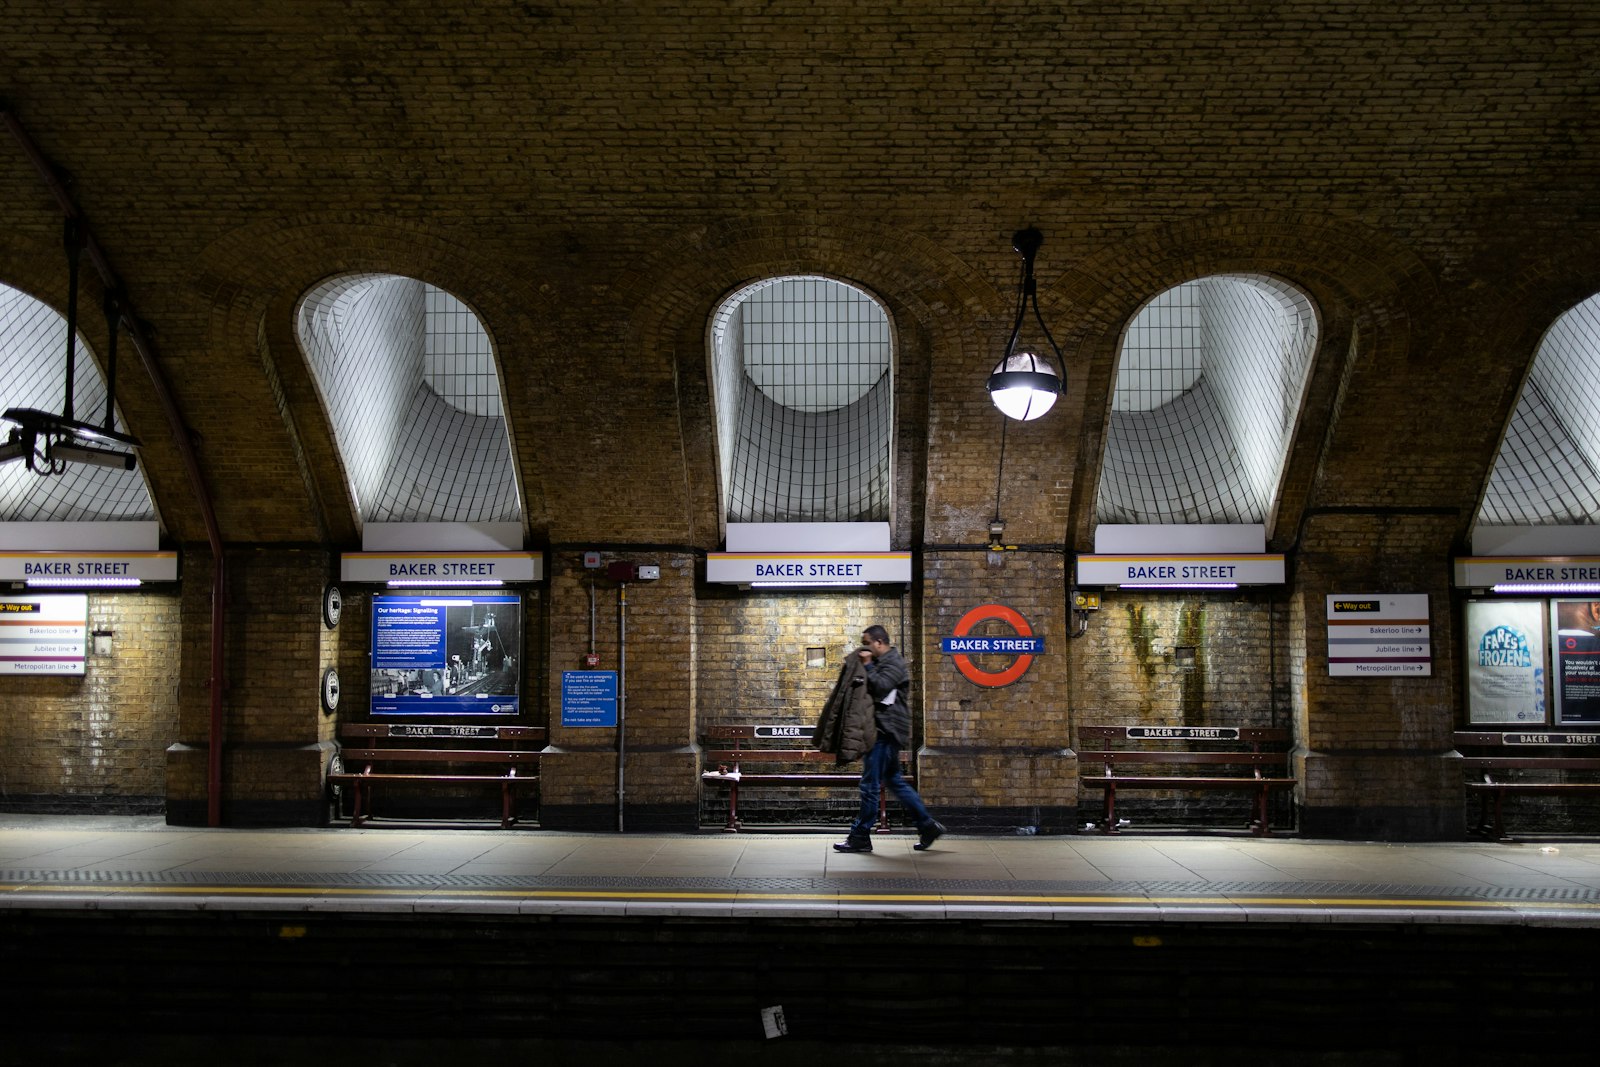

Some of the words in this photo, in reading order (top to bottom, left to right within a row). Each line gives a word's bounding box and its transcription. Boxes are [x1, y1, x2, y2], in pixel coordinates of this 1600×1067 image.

[25, 563, 71, 574] BAKER
[78, 562, 130, 574] STREET
[390, 564, 436, 575] BAKER
[442, 564, 495, 575] STREET
[756, 564, 804, 576] BAKER
[810, 564, 862, 576] STREET
[1128, 566, 1176, 578] BAKER
[1182, 566, 1236, 578] STREET
[1506, 568, 1555, 580] BAKER
[1561, 568, 1600, 580] STRE
[950, 640, 990, 650] BAKER
[993, 640, 1036, 650] STREET
[1484, 628, 1518, 650] FARES
[1478, 650, 1524, 666] FROZEN
[406, 727, 434, 735] BAKER
[450, 727, 480, 736] STREET
